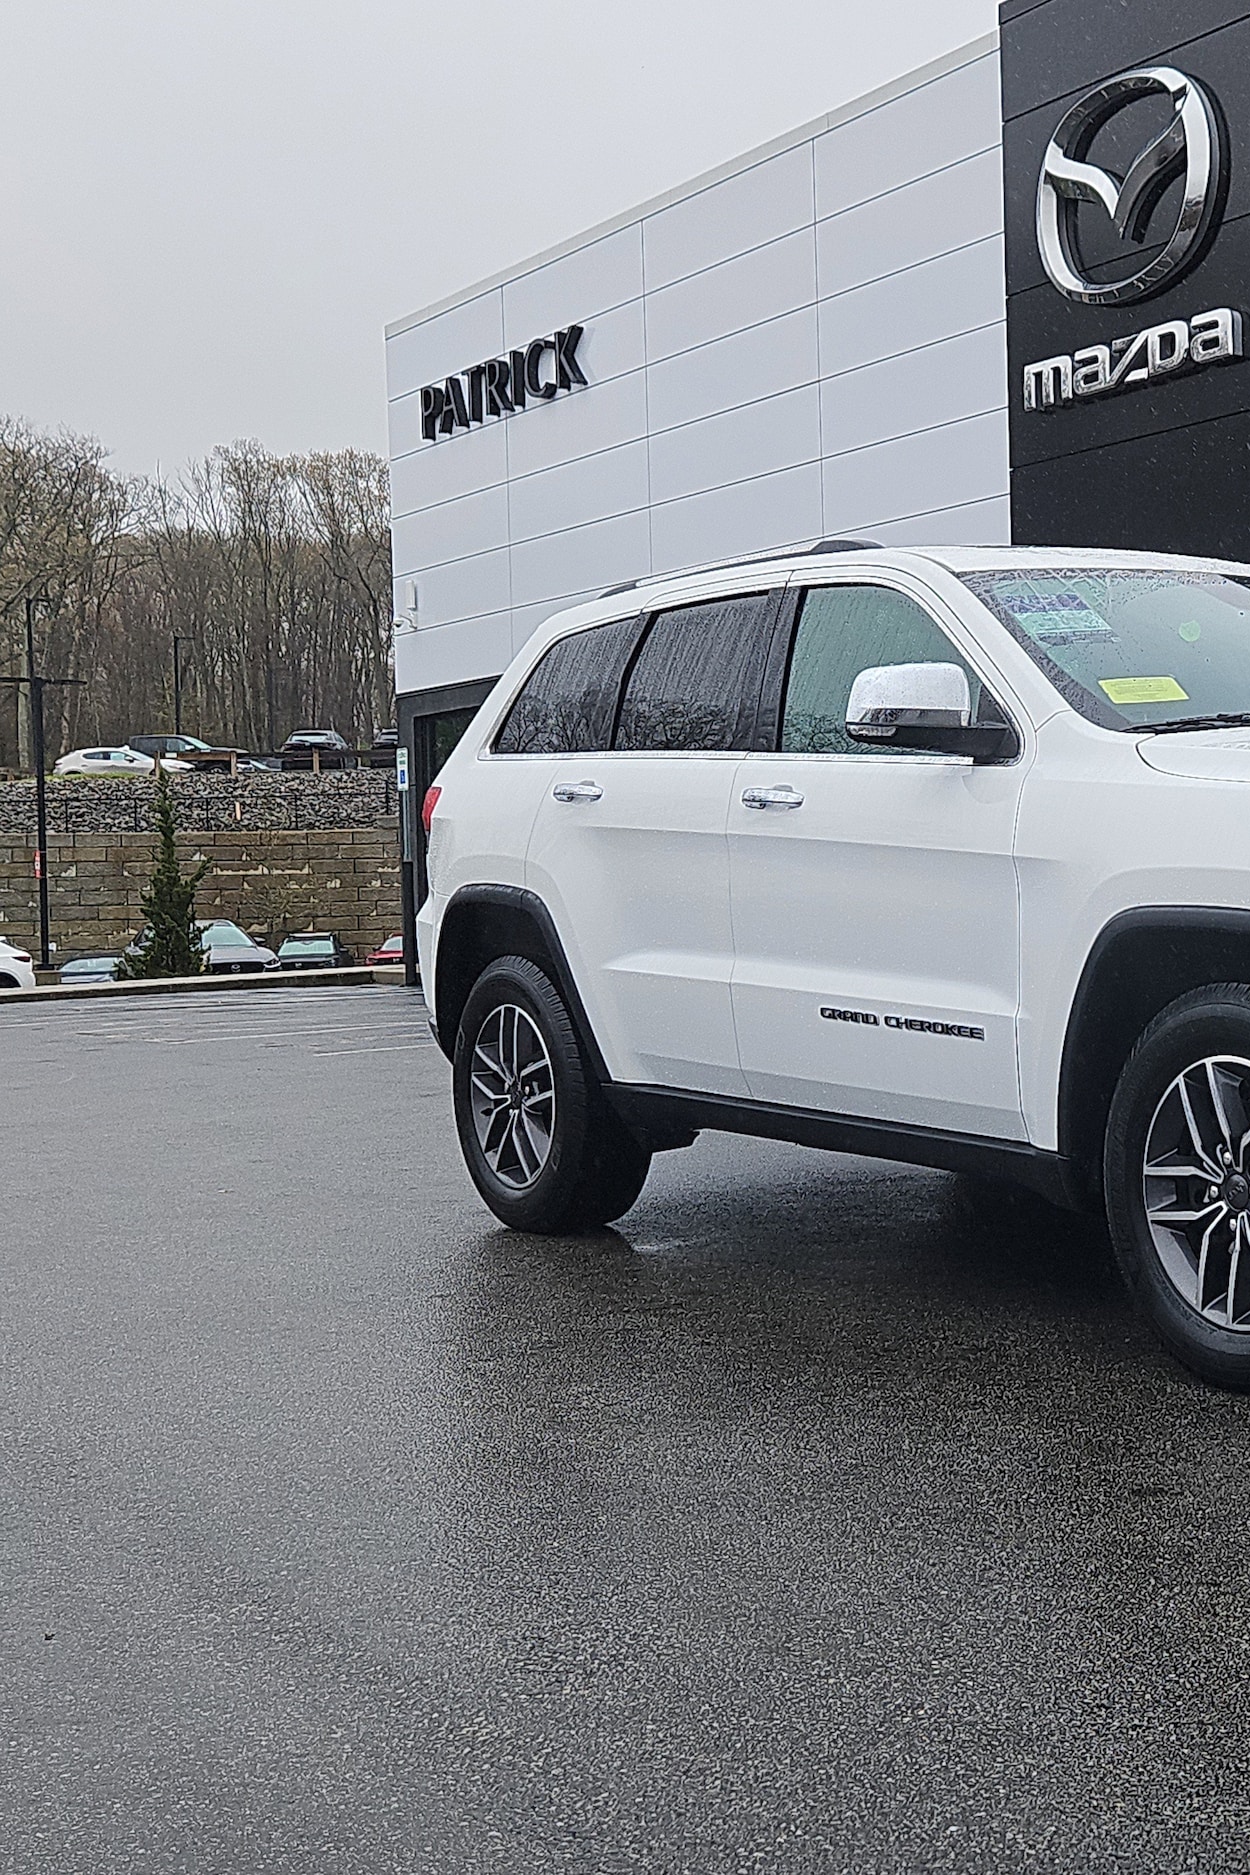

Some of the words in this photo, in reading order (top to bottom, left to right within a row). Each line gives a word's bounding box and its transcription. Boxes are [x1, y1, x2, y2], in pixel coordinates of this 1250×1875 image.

[420, 325, 588, 442] PATRICK
[1023, 307, 1243, 412] mazda
[820, 1007, 879, 1026] GRAND
[884, 1015, 985, 1041] CHEROKEE
